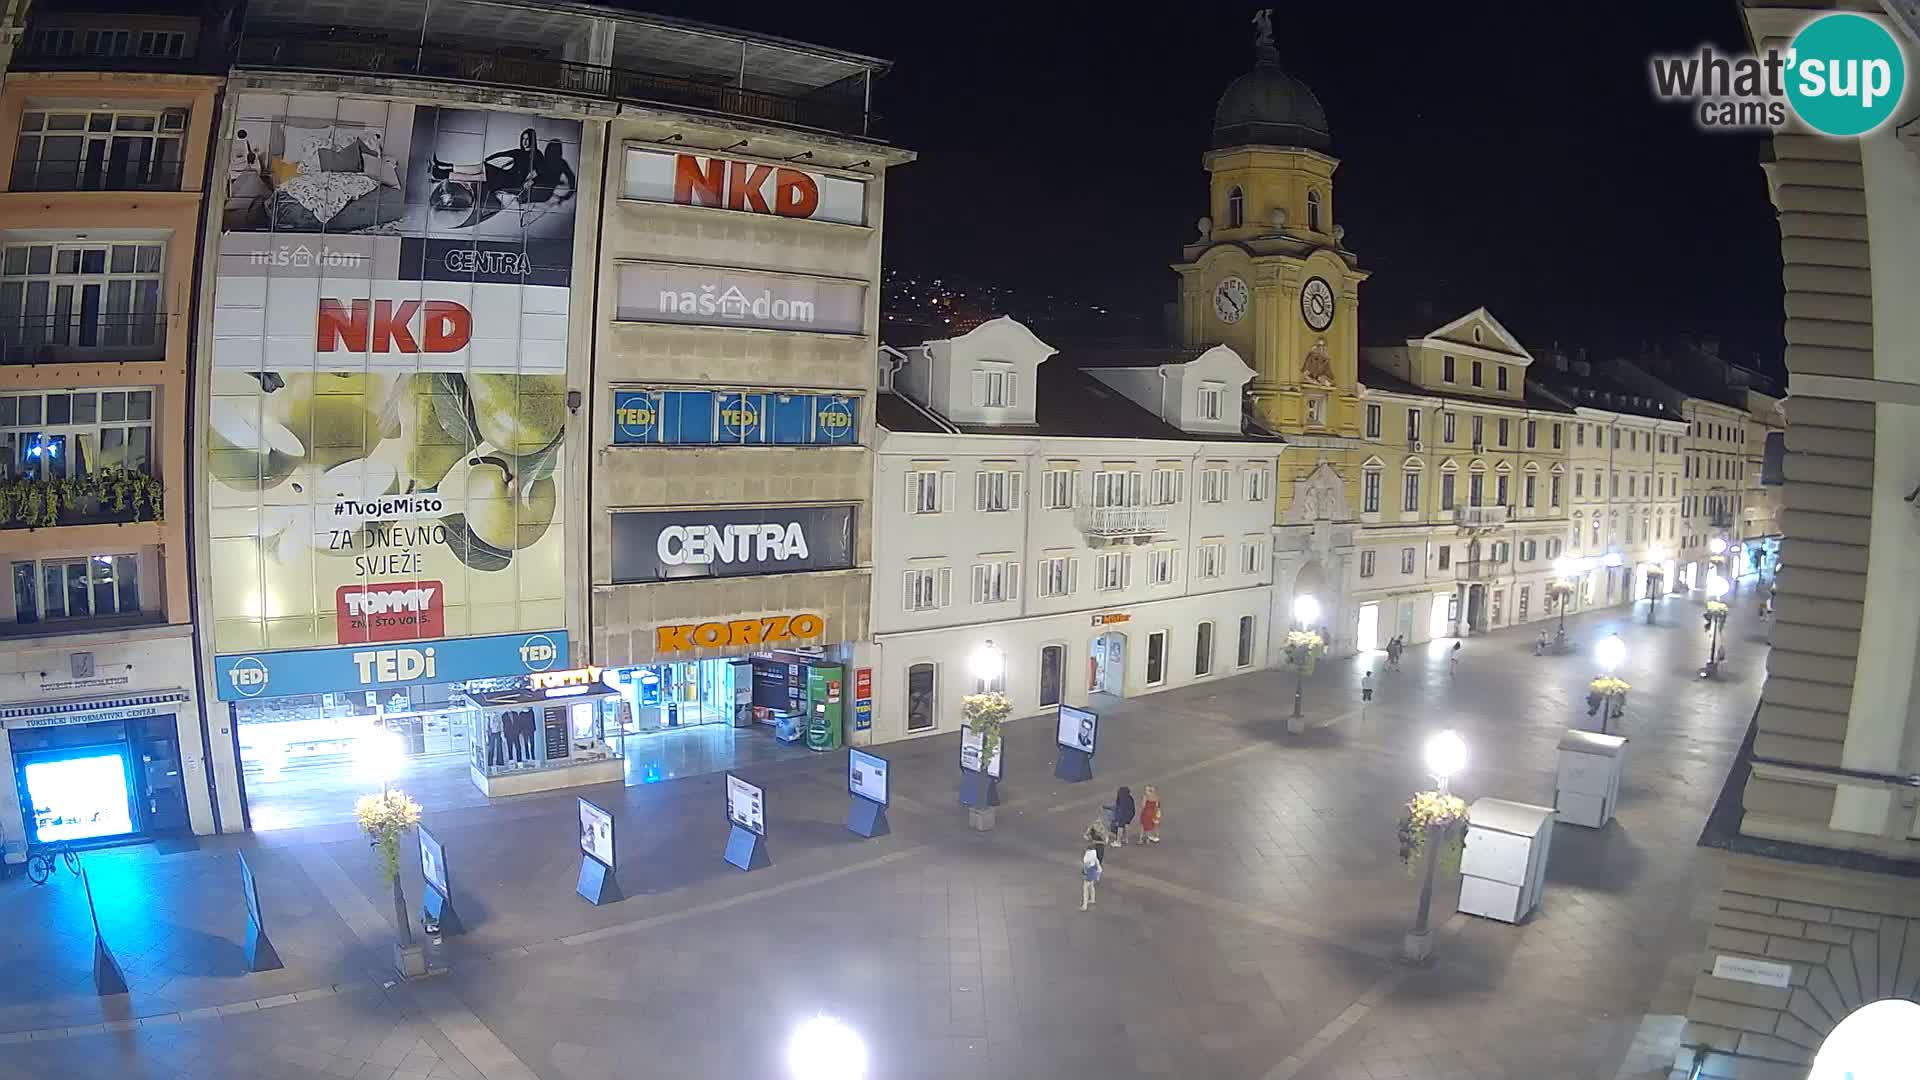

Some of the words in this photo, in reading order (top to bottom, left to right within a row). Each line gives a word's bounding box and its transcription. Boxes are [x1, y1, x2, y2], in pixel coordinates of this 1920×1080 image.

[673, 153, 819, 219] NKD
[444, 249, 533, 276] CENTRA
[316, 298, 473, 354] NKD
[334, 498, 443, 518] #TvojeMisto
[329, 529, 353, 550] ZA
[364, 524, 448, 549] DNEVNO
[657, 522, 809, 566] CENTRA
[355, 548, 423, 577] SVJEŽE
[344, 588, 436, 616] TOMMY
[656, 613, 824, 654] KORZO
[354, 647, 436, 685] TEDi
[519, 645, 557, 662] TEDi
[229, 668, 269, 686] TEDi
